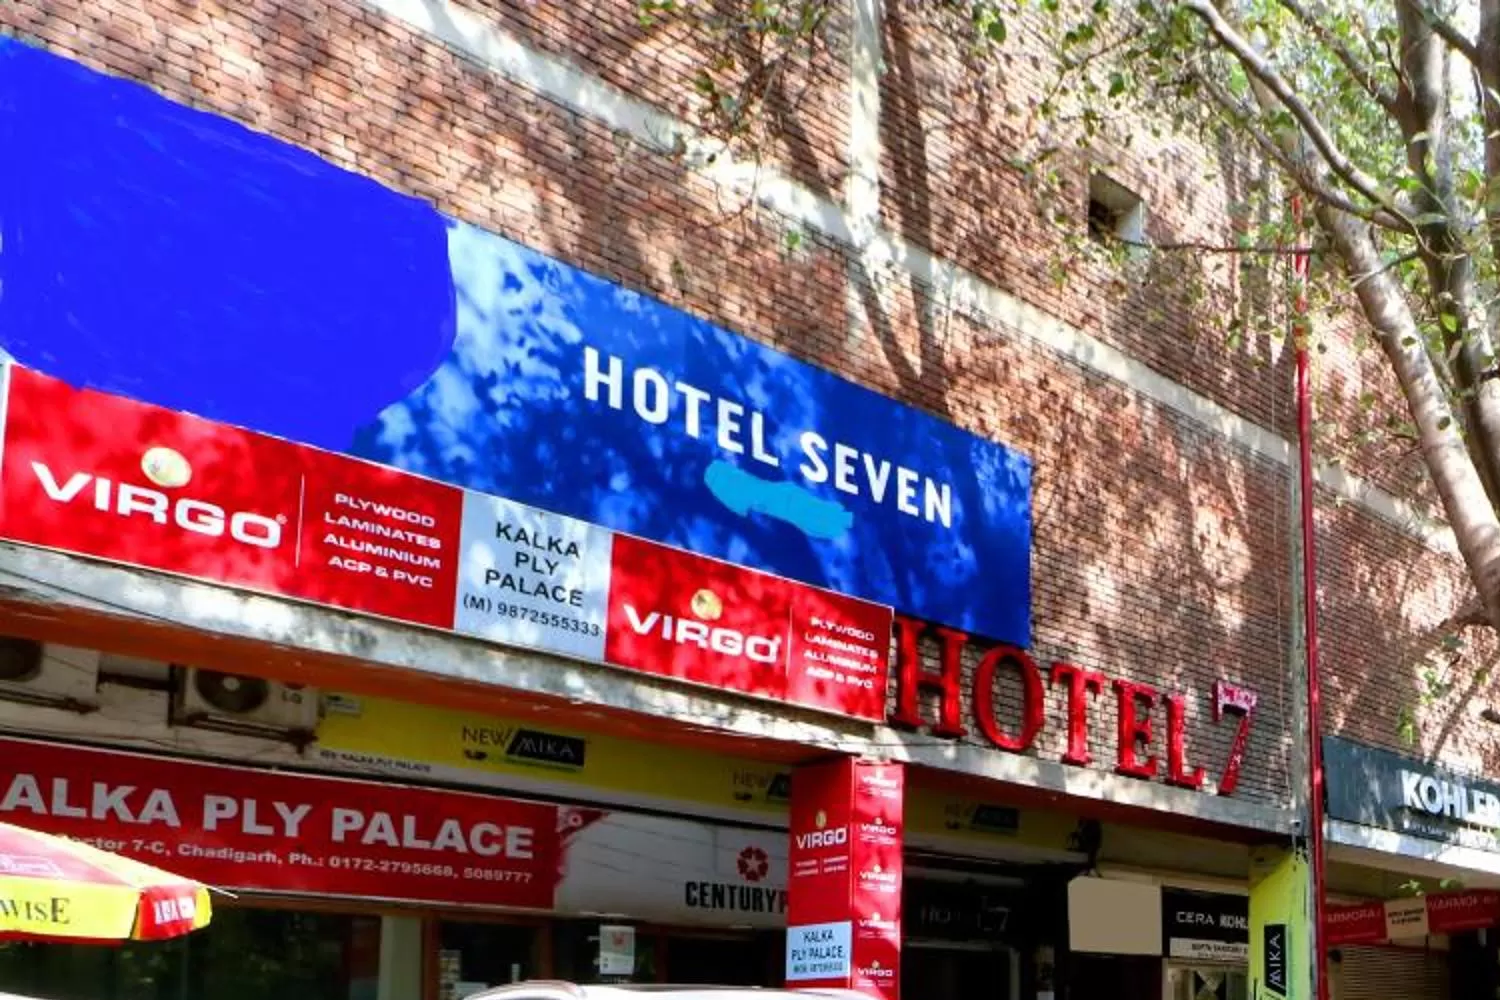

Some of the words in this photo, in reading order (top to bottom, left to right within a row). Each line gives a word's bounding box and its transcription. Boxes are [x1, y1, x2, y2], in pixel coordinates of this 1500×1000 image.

[583, 346, 780, 467] HOTEL
[799, 430, 953, 529] SEVEN
[30, 460, 282, 549] VIRGO
[334, 492, 436, 528] PLYWOOD
[324, 511, 442, 549] LAMINATES
[495, 521, 580, 559] KALKA
[323, 533, 441, 569] ALUMINIUM
[514, 551, 559, 576] PLY
[328, 555, 372, 573] ACP
[375, 566, 388, 578] &
[393, 570, 433, 588] PVC
[485, 569, 583, 607] PALACE
[463, 592, 492, 612] (M)
[497, 602, 600, 637] 9872555333
[623, 604, 778, 663] VIRGO
[888, 616, 1207, 792] HOTEL
[1212, 680, 1258, 796] 7
[462, 727, 509, 747] NEW
[517, 738, 575, 760] MIKA
[0, 773, 181, 827] ALKA
[203, 794, 312, 838] PLY
[331, 807, 534, 860] PALACE
[796, 827, 847, 849] VIRGO
[1176, 911, 1215, 926] CERA
